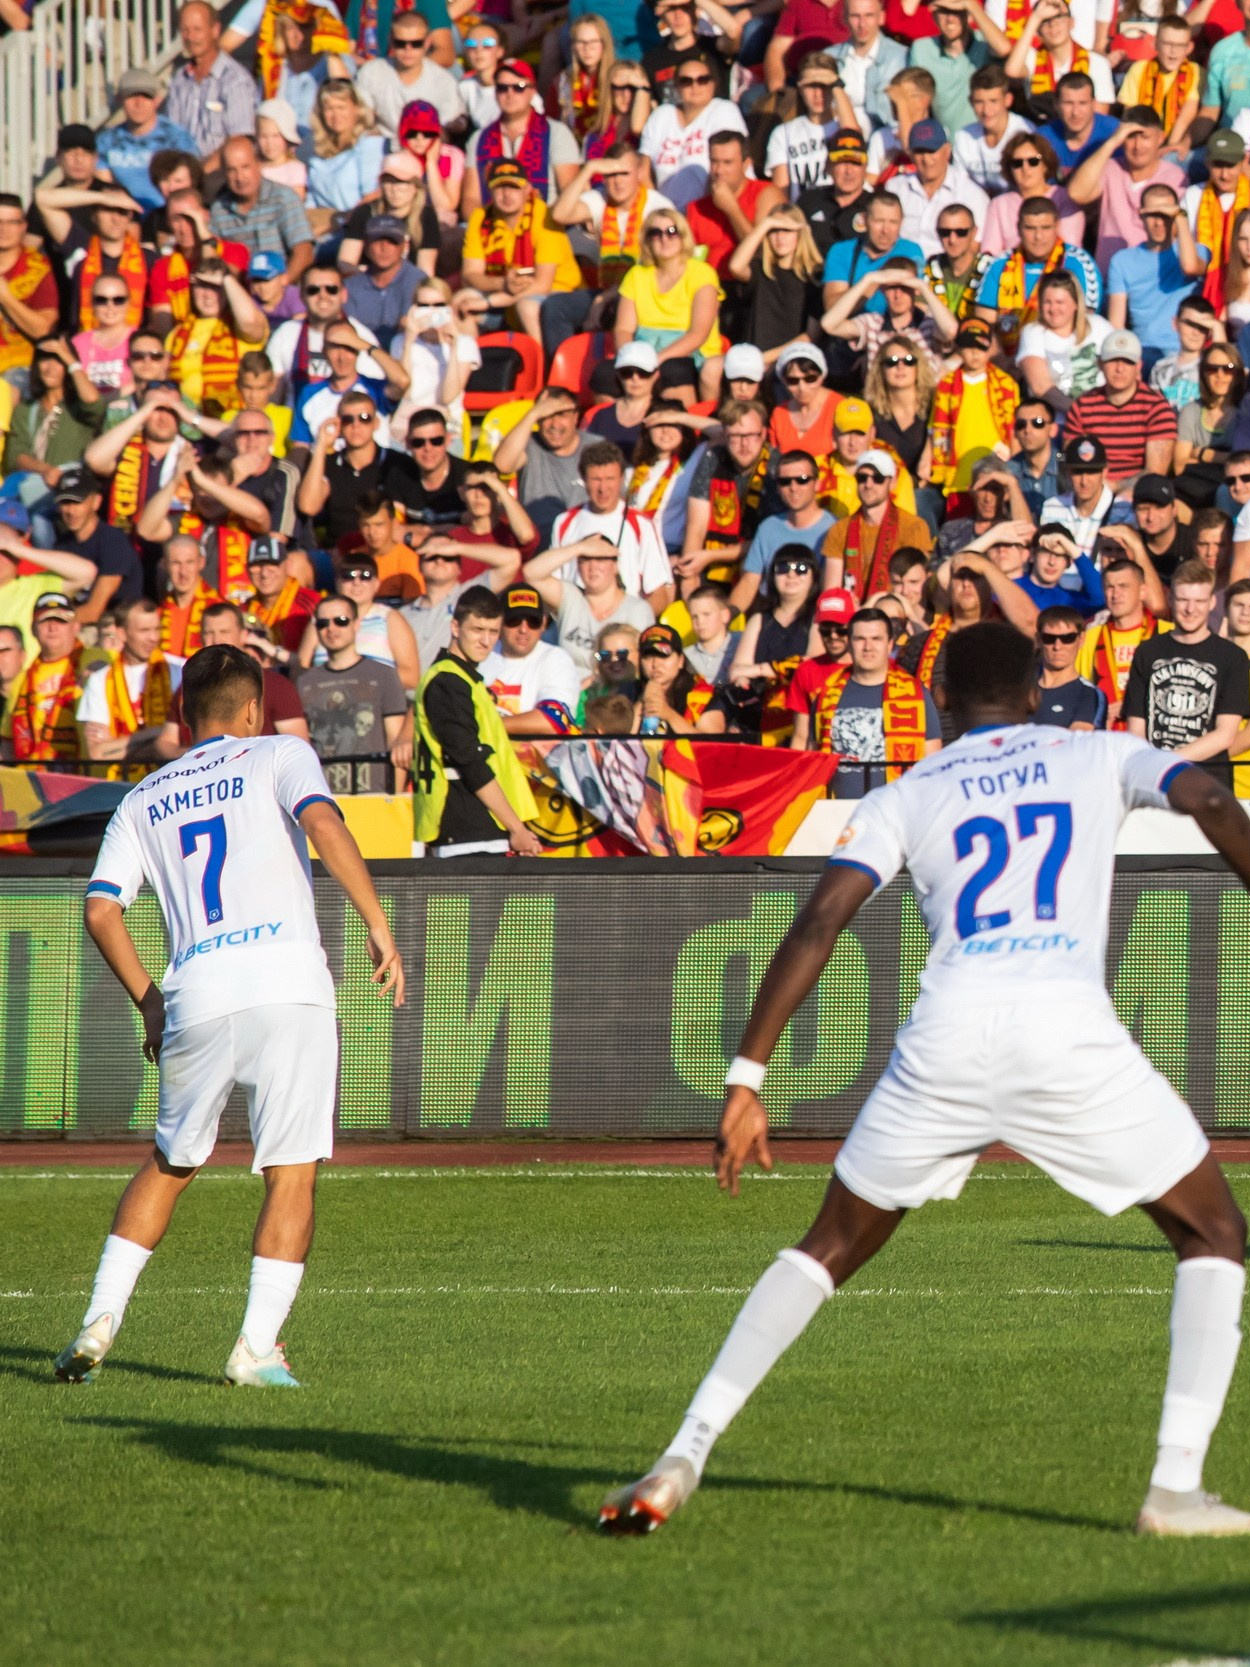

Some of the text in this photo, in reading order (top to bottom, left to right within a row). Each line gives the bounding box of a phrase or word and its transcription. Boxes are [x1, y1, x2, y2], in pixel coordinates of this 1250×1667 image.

[133, 754, 228, 796] АЭРОФЛОТ
[960, 762, 1048, 800] ГОГУА
[147, 776, 245, 827] АХМЕТОВ
[178, 812, 227, 926] 7
[953, 801, 1073, 941] 27
